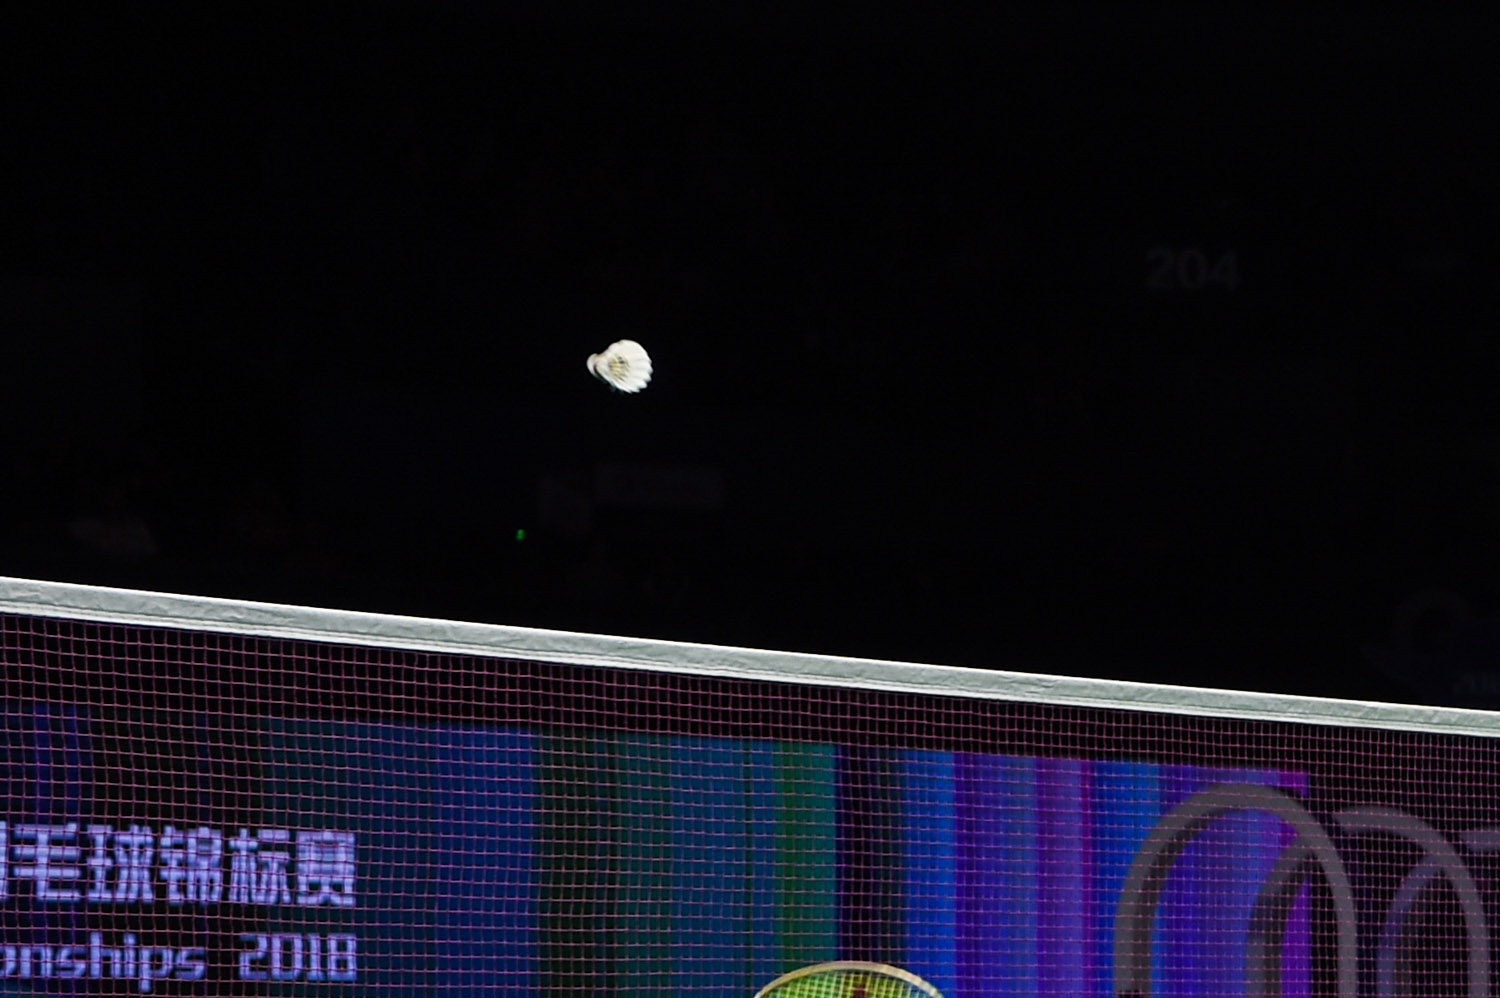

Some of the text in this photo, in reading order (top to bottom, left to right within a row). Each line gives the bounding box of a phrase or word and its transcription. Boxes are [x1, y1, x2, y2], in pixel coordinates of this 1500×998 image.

[1146, 245, 1240, 288] 204
[0, 820, 357, 908] 毛球锦标赛
[239, 932, 357, 982] 2018
